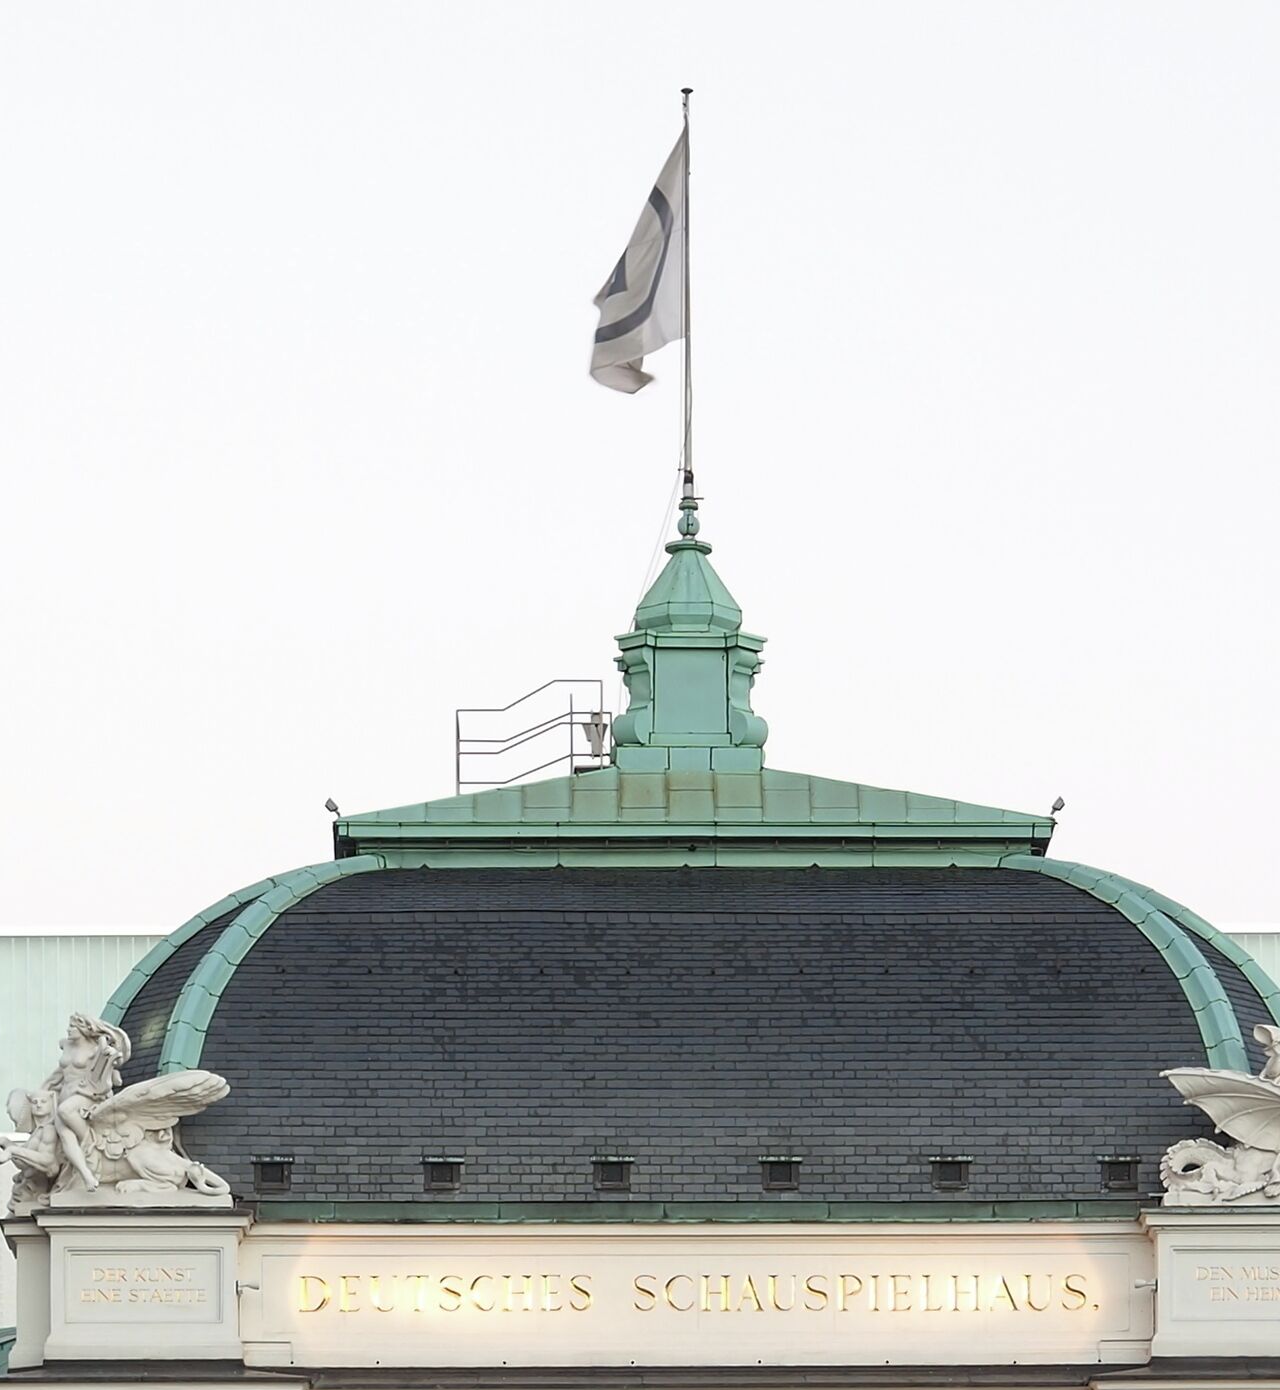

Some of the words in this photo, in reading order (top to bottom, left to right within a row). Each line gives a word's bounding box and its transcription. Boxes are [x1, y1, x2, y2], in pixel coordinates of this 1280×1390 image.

[93, 1267, 128, 1282] DER
[134, 1267, 197, 1283] KUNST
[1195, 1266, 1234, 1281] DEN
[80, 1288, 122, 1303] EINE
[127, 1288, 208, 1303] STAETTE
[298, 1274, 593, 1313] DEUTSCHES
[633, 1273, 1100, 1313] SCHAUSPIELHAUS.
[1210, 1286, 1240, 1301] EIN
